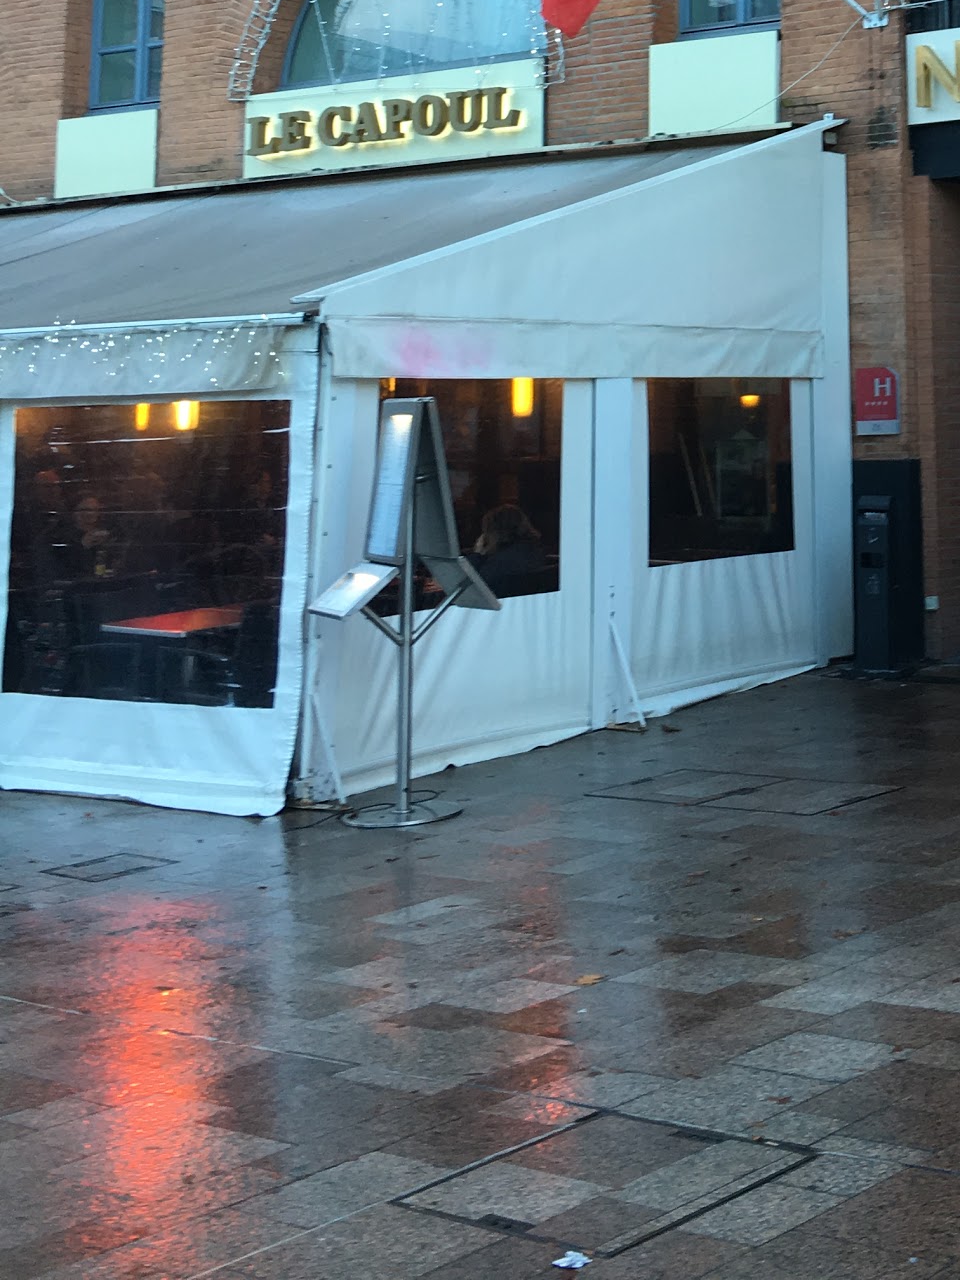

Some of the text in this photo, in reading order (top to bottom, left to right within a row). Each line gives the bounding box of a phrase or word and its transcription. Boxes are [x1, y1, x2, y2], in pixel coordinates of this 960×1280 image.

[248, 87, 521, 156] LE CAPOUL
[873, 377, 892, 397] H
